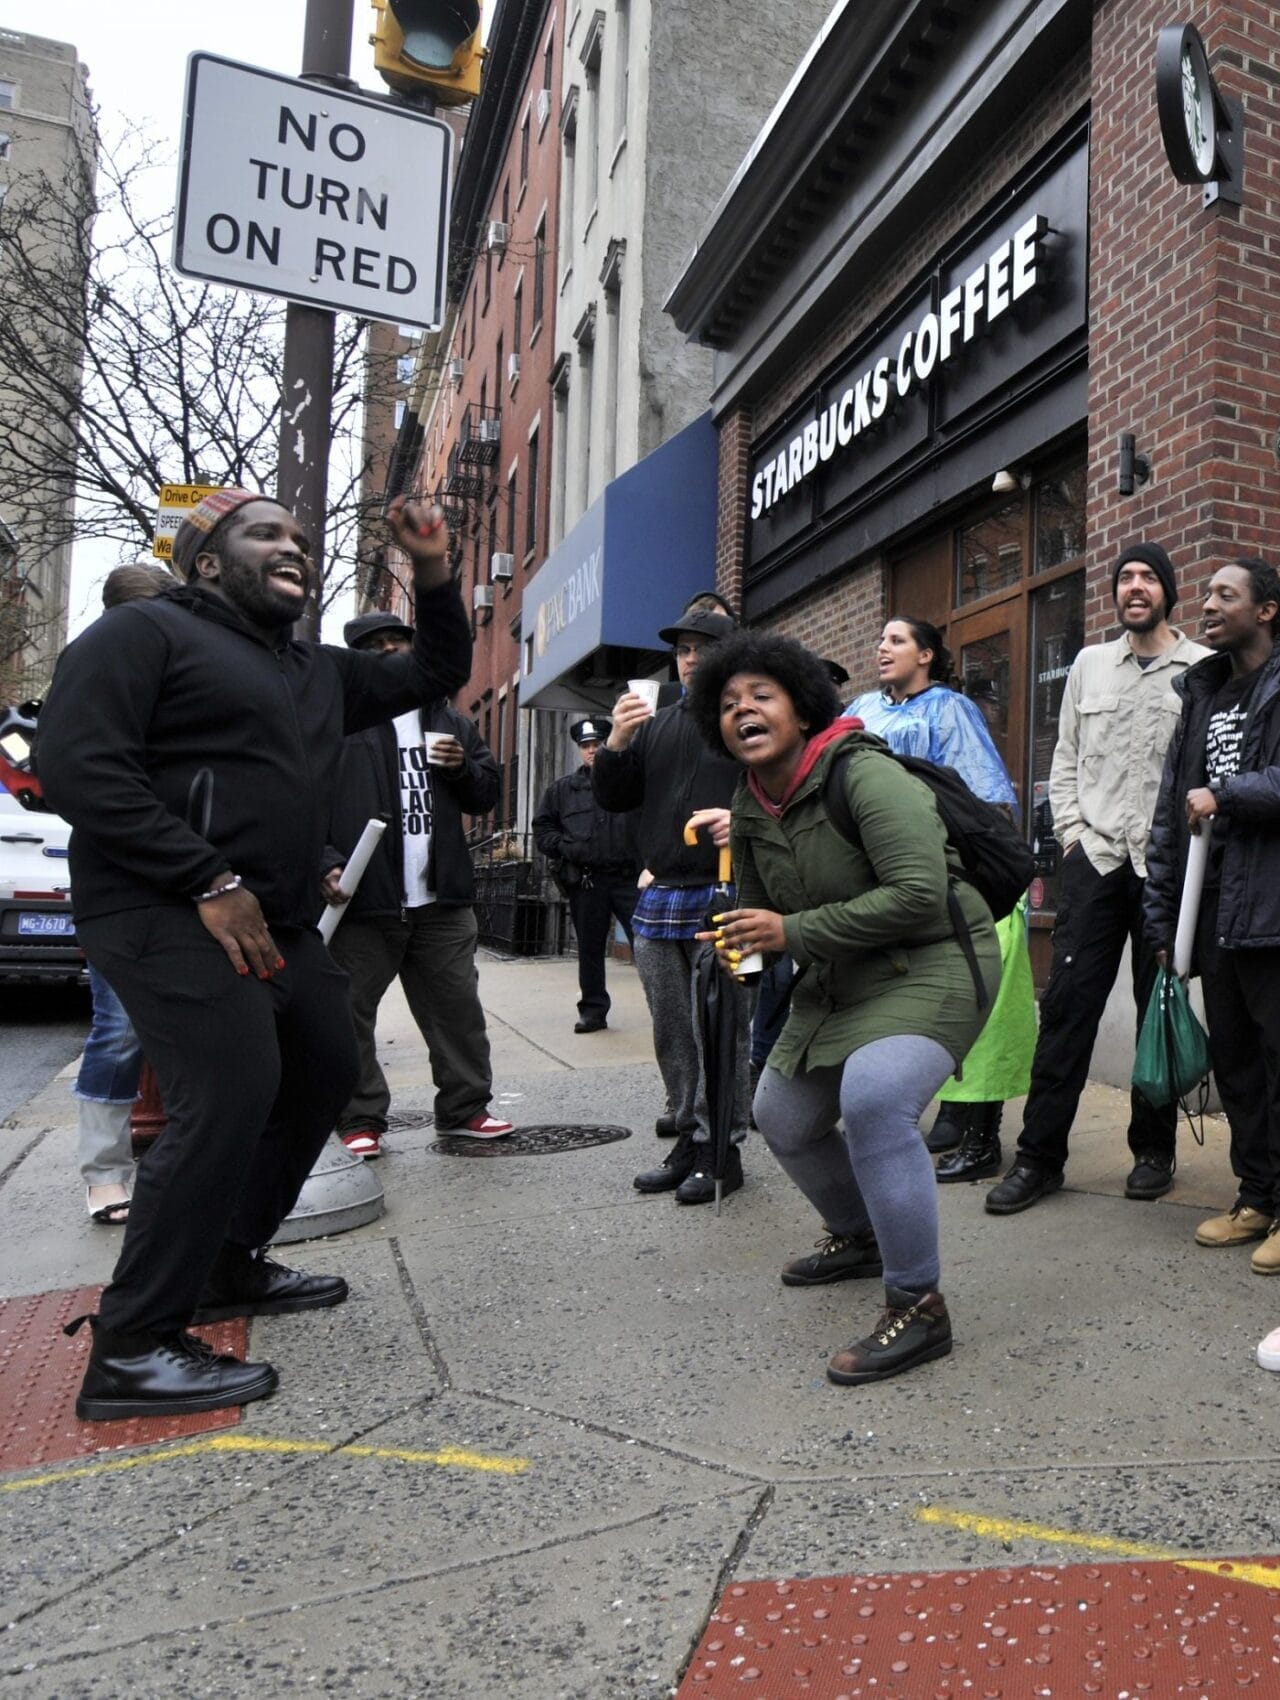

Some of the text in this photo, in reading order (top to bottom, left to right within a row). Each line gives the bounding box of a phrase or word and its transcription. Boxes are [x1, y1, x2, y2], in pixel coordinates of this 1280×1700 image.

[278, 105, 366, 162] NO
[249, 158, 388, 231] TURN
[206, 213, 417, 295] ON RED
[751, 213, 1041, 520] STARBUCKS COFFEE
[164, 489, 189, 503] Drive
[567, 545, 601, 624] BANK
